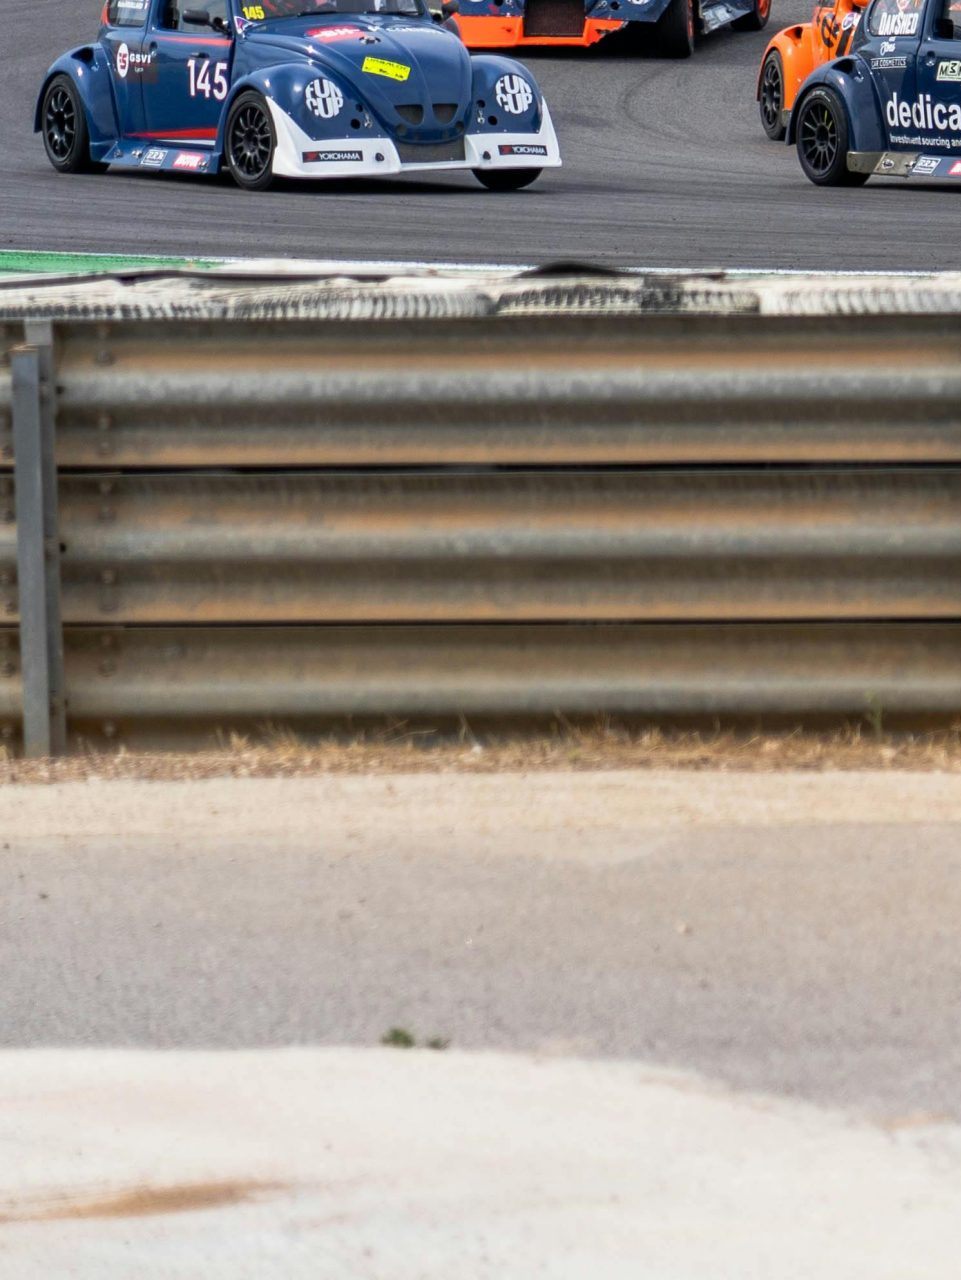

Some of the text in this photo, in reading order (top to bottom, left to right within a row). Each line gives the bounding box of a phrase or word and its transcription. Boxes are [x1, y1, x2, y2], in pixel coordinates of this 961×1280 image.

[242, 6, 265, 20] 145
[130, 53, 151, 64] GSVI
[187, 59, 228, 100] 145
[495, 74, 532, 95] FUN
[305, 78, 342, 99] FUN
[306, 96, 344, 119] CUP
[496, 92, 532, 114] CUP
[511, 145, 546, 154] YOKOHAMA
[922, 136, 950, 149] sourcing
[318, 151, 361, 160] YOKOHAMA
